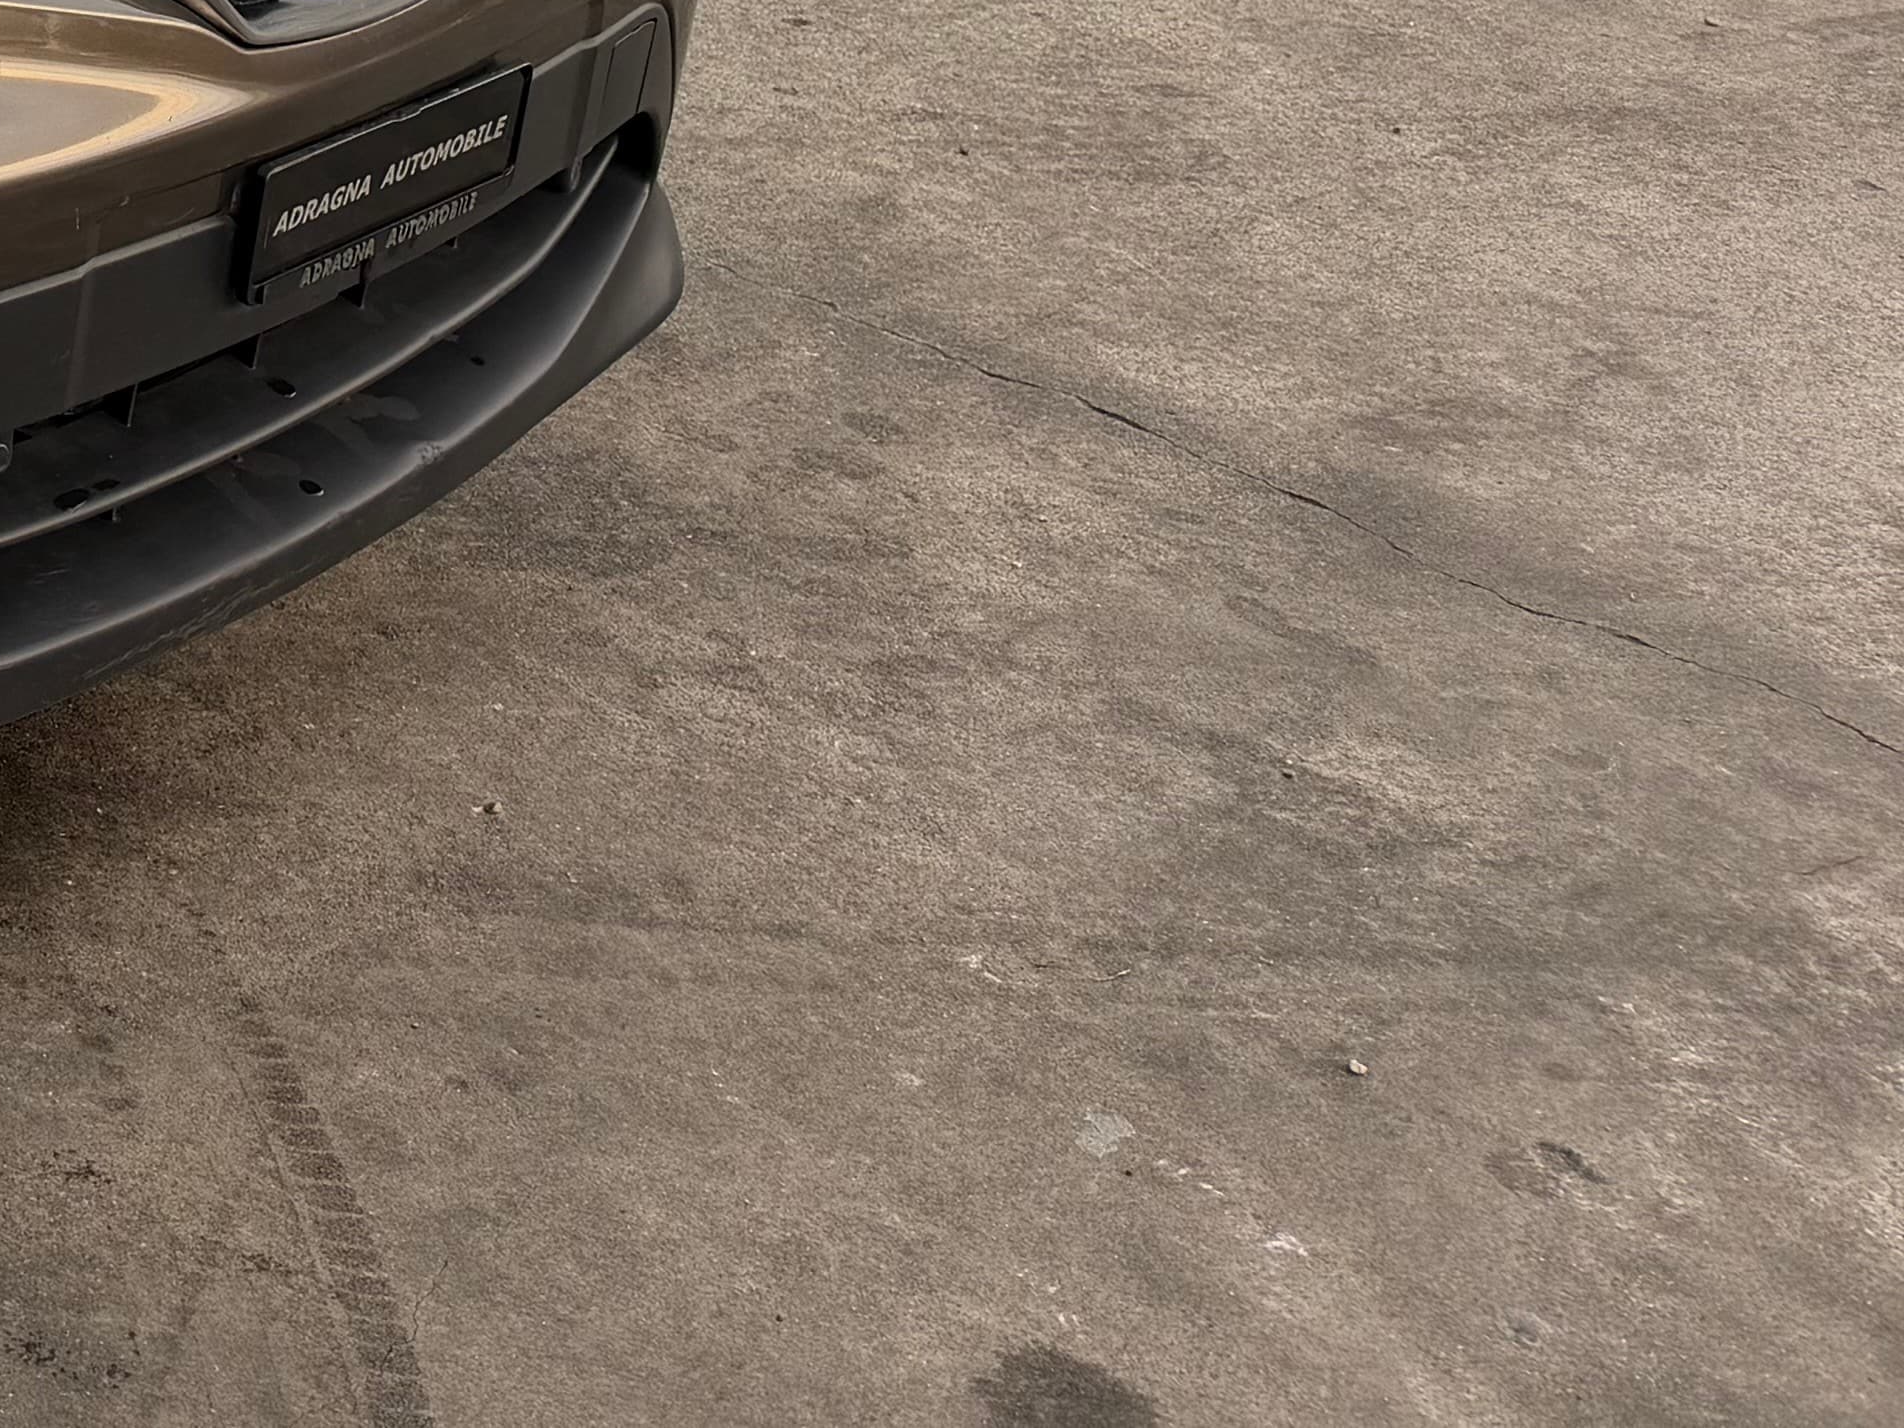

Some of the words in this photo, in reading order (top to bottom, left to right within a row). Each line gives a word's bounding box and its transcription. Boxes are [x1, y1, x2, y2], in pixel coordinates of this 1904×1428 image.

[272, 174, 372, 237] ADRAGNA
[380, 114, 508, 189] AUTOMOBILE
[299, 237, 375, 288] ADRAGNA
[385, 191, 478, 249] AUTOMOBILE
